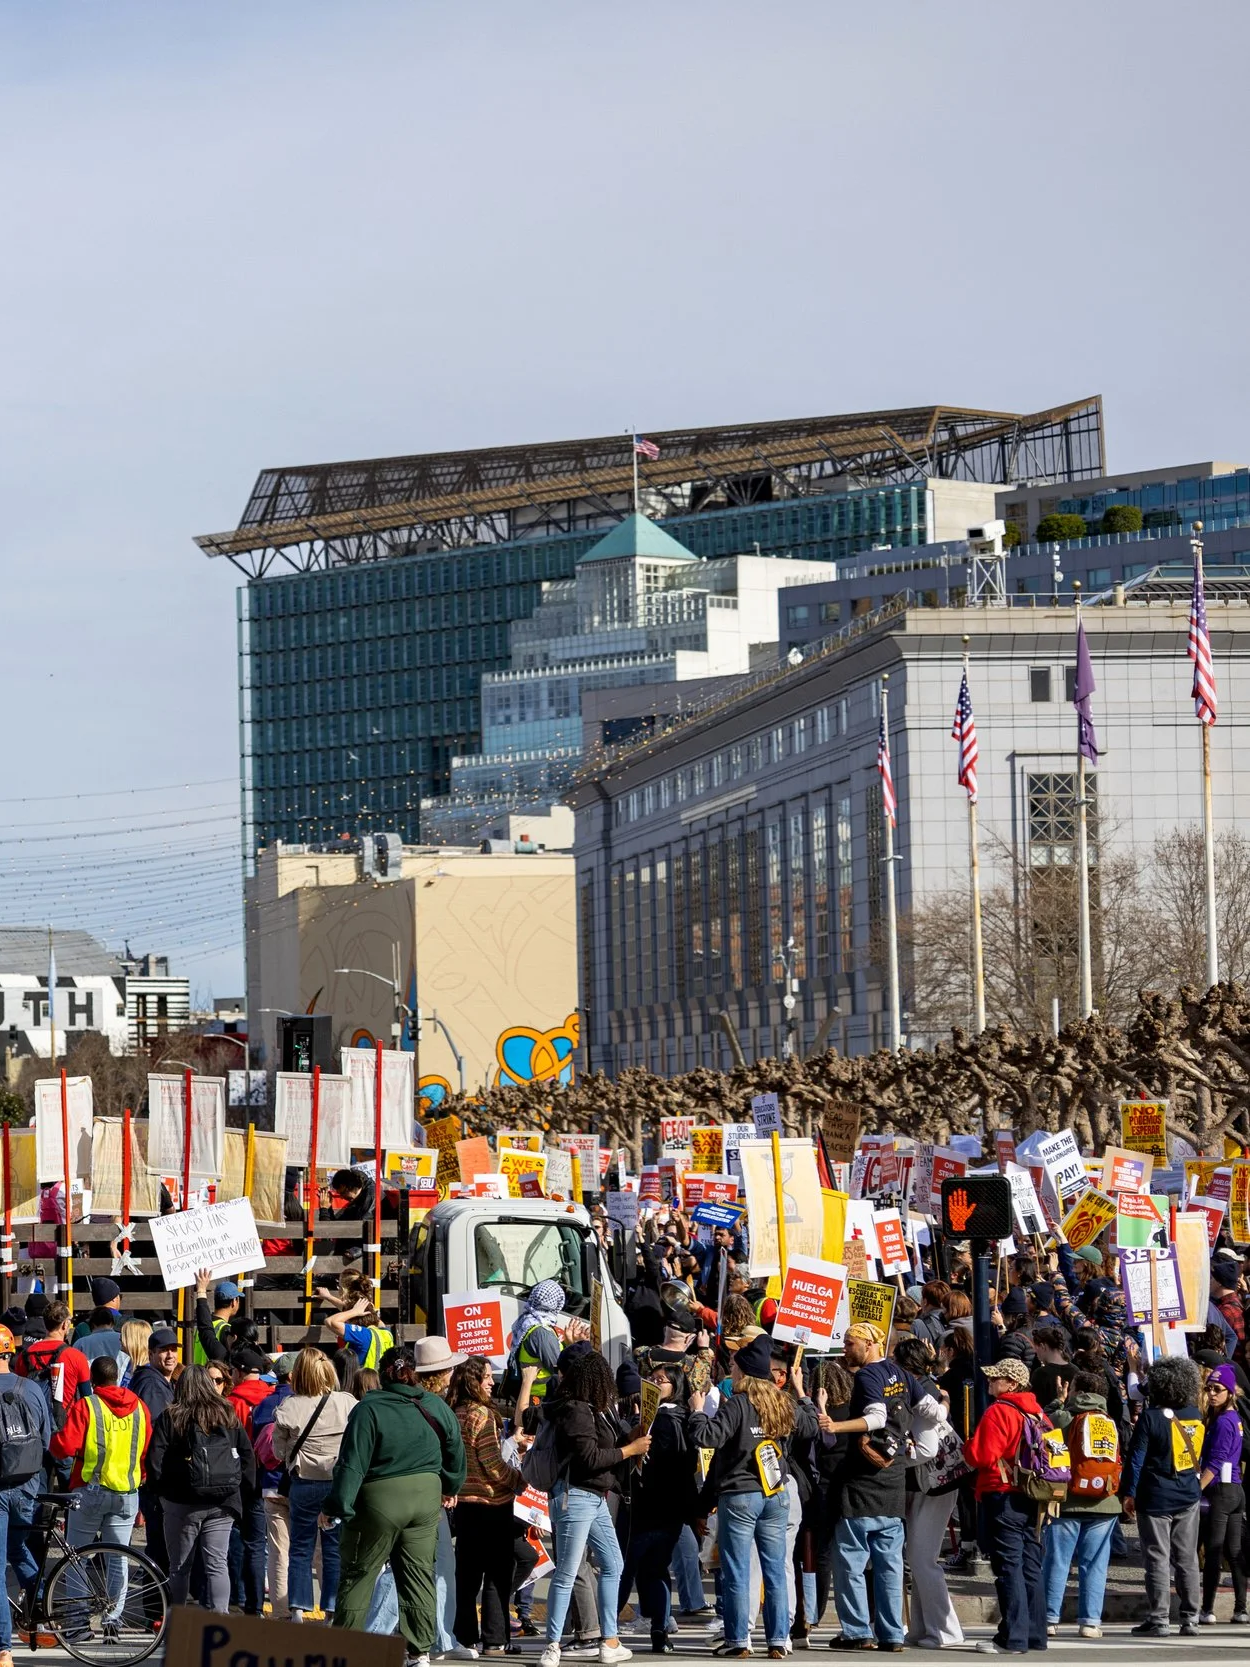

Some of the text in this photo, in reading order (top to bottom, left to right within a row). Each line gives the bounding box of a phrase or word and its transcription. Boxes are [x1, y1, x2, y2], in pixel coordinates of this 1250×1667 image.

[754, 1104, 775, 1114] EDUCATORS
[828, 1102, 858, 1114] CAN YOU
[1132, 1106, 1156, 1115] NO
[757, 1113, 777, 1126] STRIKE
[824, 1112, 843, 1121] READ
[1129, 1115, 1162, 1126] PODEMOS
[736, 1125, 749, 1133] OUR
[827, 1121, 855, 1130] THIS??
[1131, 1125, 1160, 1135] ESPERAR
[701, 1132, 722, 1140] WE
[728, 1132, 757, 1140] STUDENTS
[822, 1129, 843, 1138] THANK
[726, 1139, 738, 1147] ARE
[1042, 1135, 1073, 1157] MAKE THE
[1046, 1146, 1076, 1166] BILLIONAIRES
[512, 1159, 534, 1168] WE
[944, 1163, 955, 1171] ON
[1057, 1166, 1080, 1185] PAY!
[420, 1177, 434, 1189] SEIU
[1086, 1194, 1095, 1203] WE
[154, 1216, 172, 1226] WTF
[165, 1212, 229, 1238] SFUSD HAS
[884, 1224, 894, 1232] ON
[221, 1233, 230, 1243] in
[882, 1234, 900, 1243] STRIKE
[791, 1279, 833, 1299] HUELGA
[848, 1288, 892, 1301] ESCUELAS CON
[794, 1295, 827, 1307] ¡ESCUELAS
[854, 1296, 884, 1307] PERSONAL
[464, 1306, 481, 1317] ON
[792, 1301, 820, 1313] SEGURAS
[851, 1303, 883, 1314] COMPLETO
[779, 1306, 833, 1325] ESTABLES AHORA!
[857, 1311, 882, 1321] ESTABLE
[456, 1318, 492, 1331] STRIKE
[460, 1331, 473, 1339] FOR
[457, 1338, 488, 1346] STUDENTS
[457, 1344, 493, 1353] EDUCATORS
[104, 1415, 132, 1434] UESF
